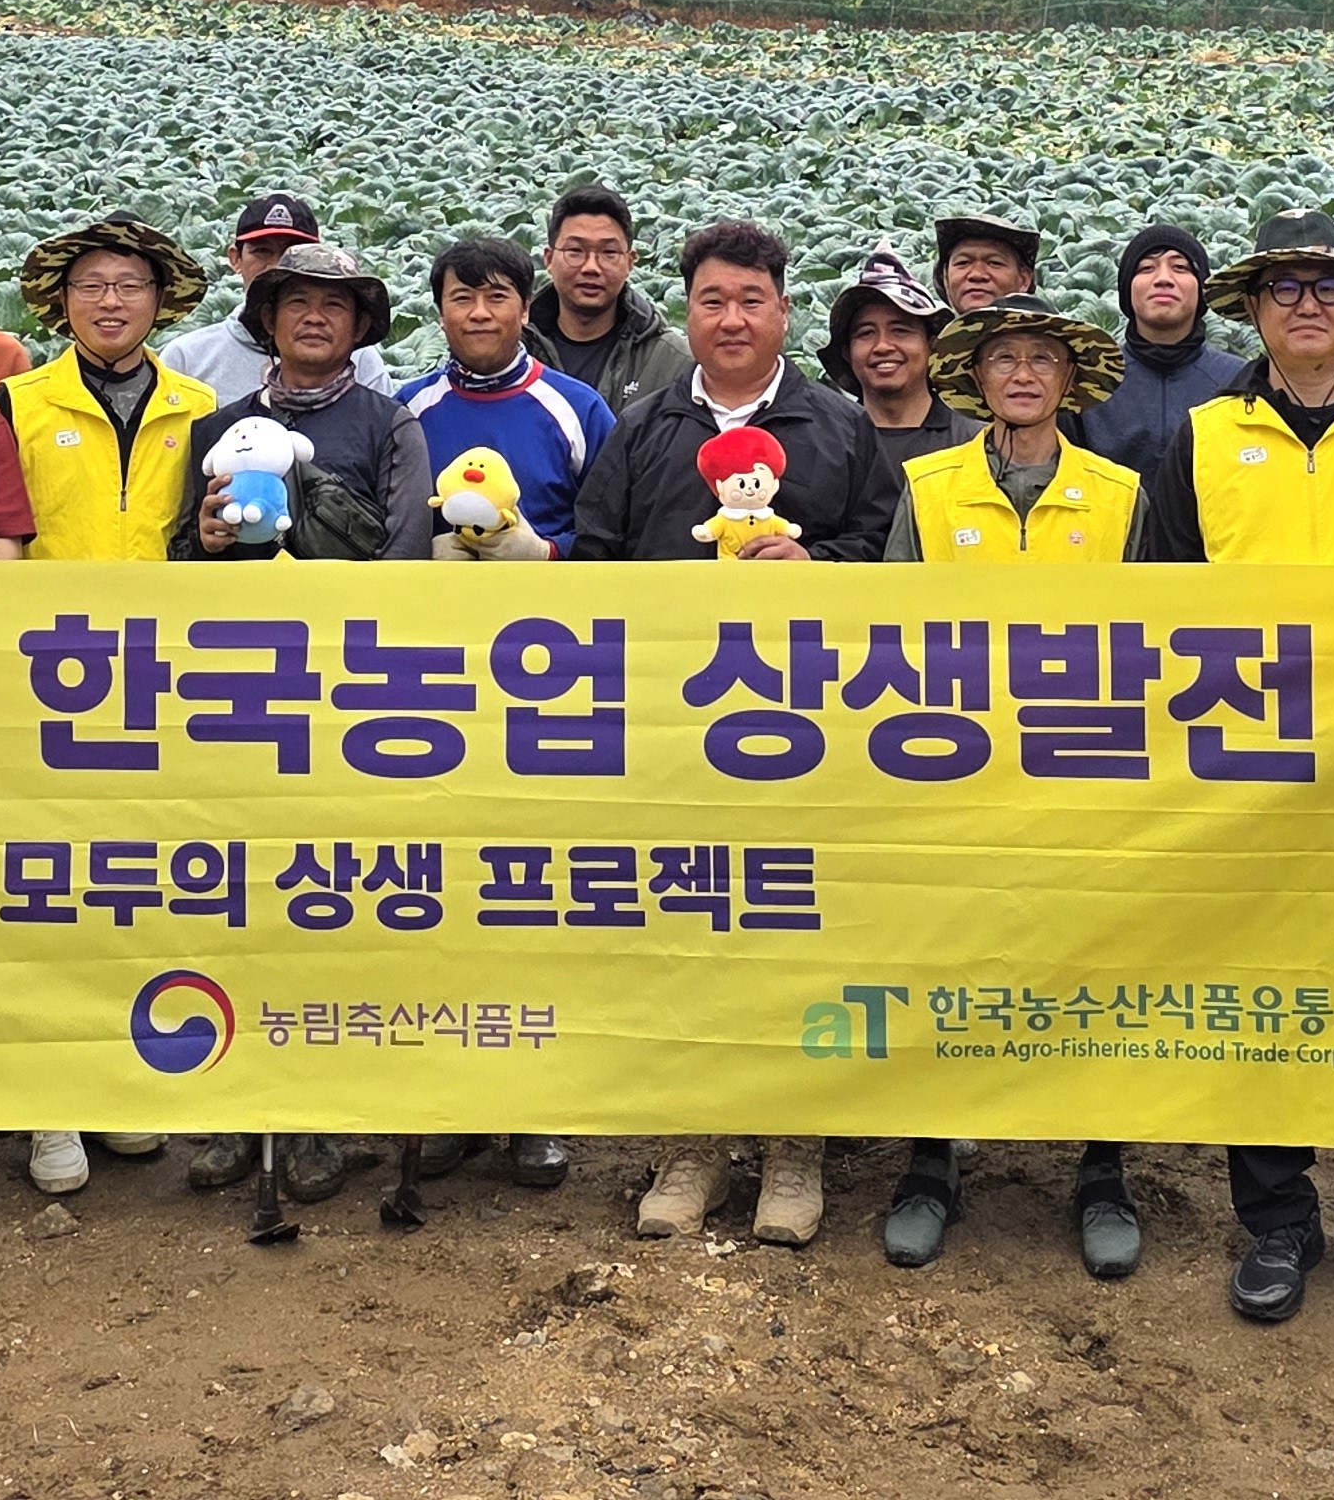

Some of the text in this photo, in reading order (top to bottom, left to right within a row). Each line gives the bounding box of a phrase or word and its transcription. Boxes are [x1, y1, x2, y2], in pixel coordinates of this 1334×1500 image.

[19, 614, 627, 778] 한국농업
[683, 619, 1317, 783] 상생발전
[0, 841, 822, 932] 모두의 상생 프로젝트
[259, 1002, 558, 1049] 농림축산식품부
[936, 1041, 996, 1059] Korea
[1002, 1038, 1150, 1062] Agro-Fisheries
[1154, 1043, 1170, 1059] &
[1174, 1040, 1226, 1061] Food
[1231, 1042, 1290, 1064] Trade
